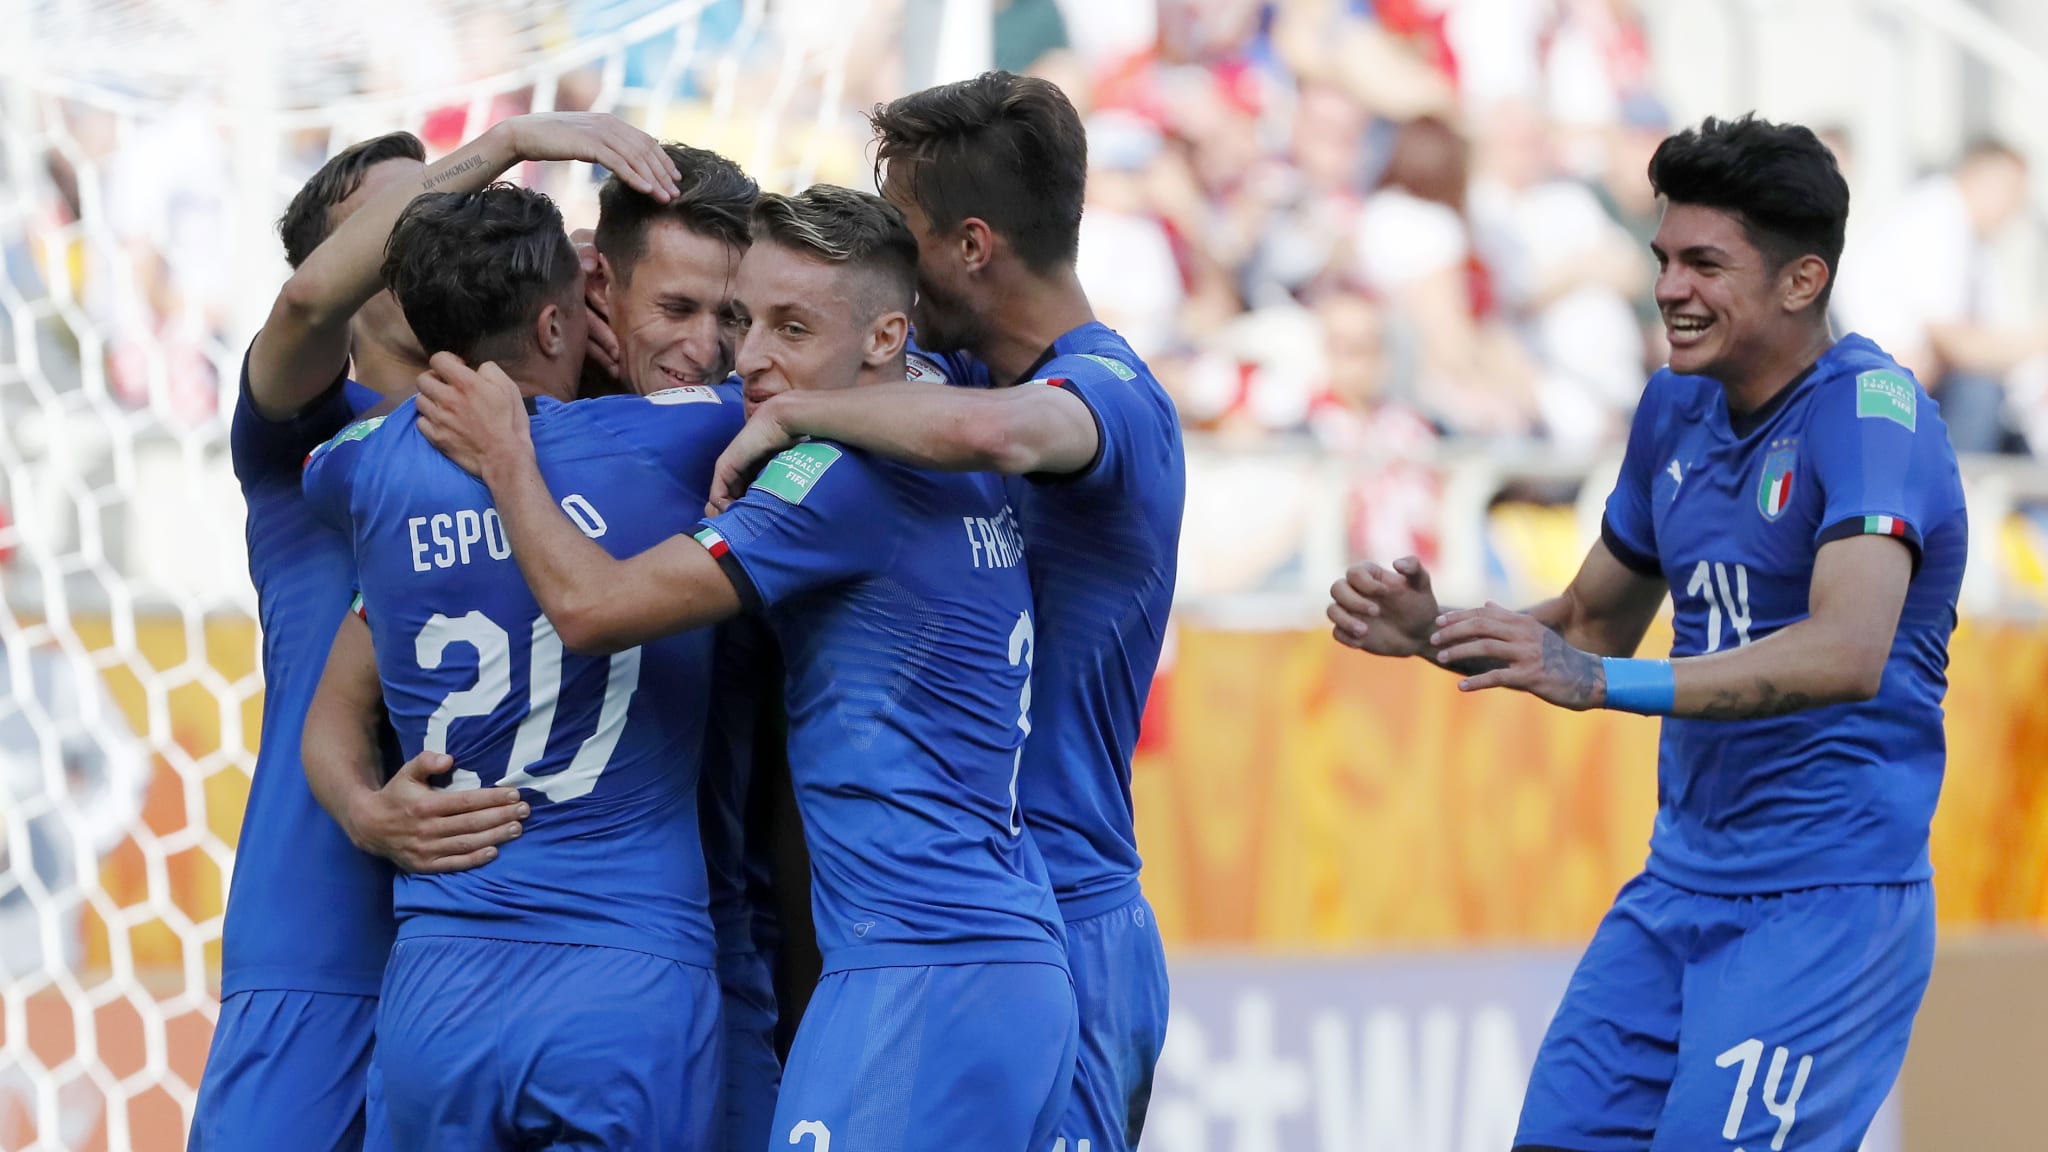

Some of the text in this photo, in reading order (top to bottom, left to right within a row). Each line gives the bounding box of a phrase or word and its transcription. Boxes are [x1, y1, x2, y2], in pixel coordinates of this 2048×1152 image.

[785, 470, 806, 488] FIFA
[408, 493, 609, 573] ESPOO
[1686, 560, 1752, 654] 14
[414, 609, 642, 804] 20
[1714, 1037, 1814, 1151] 14
